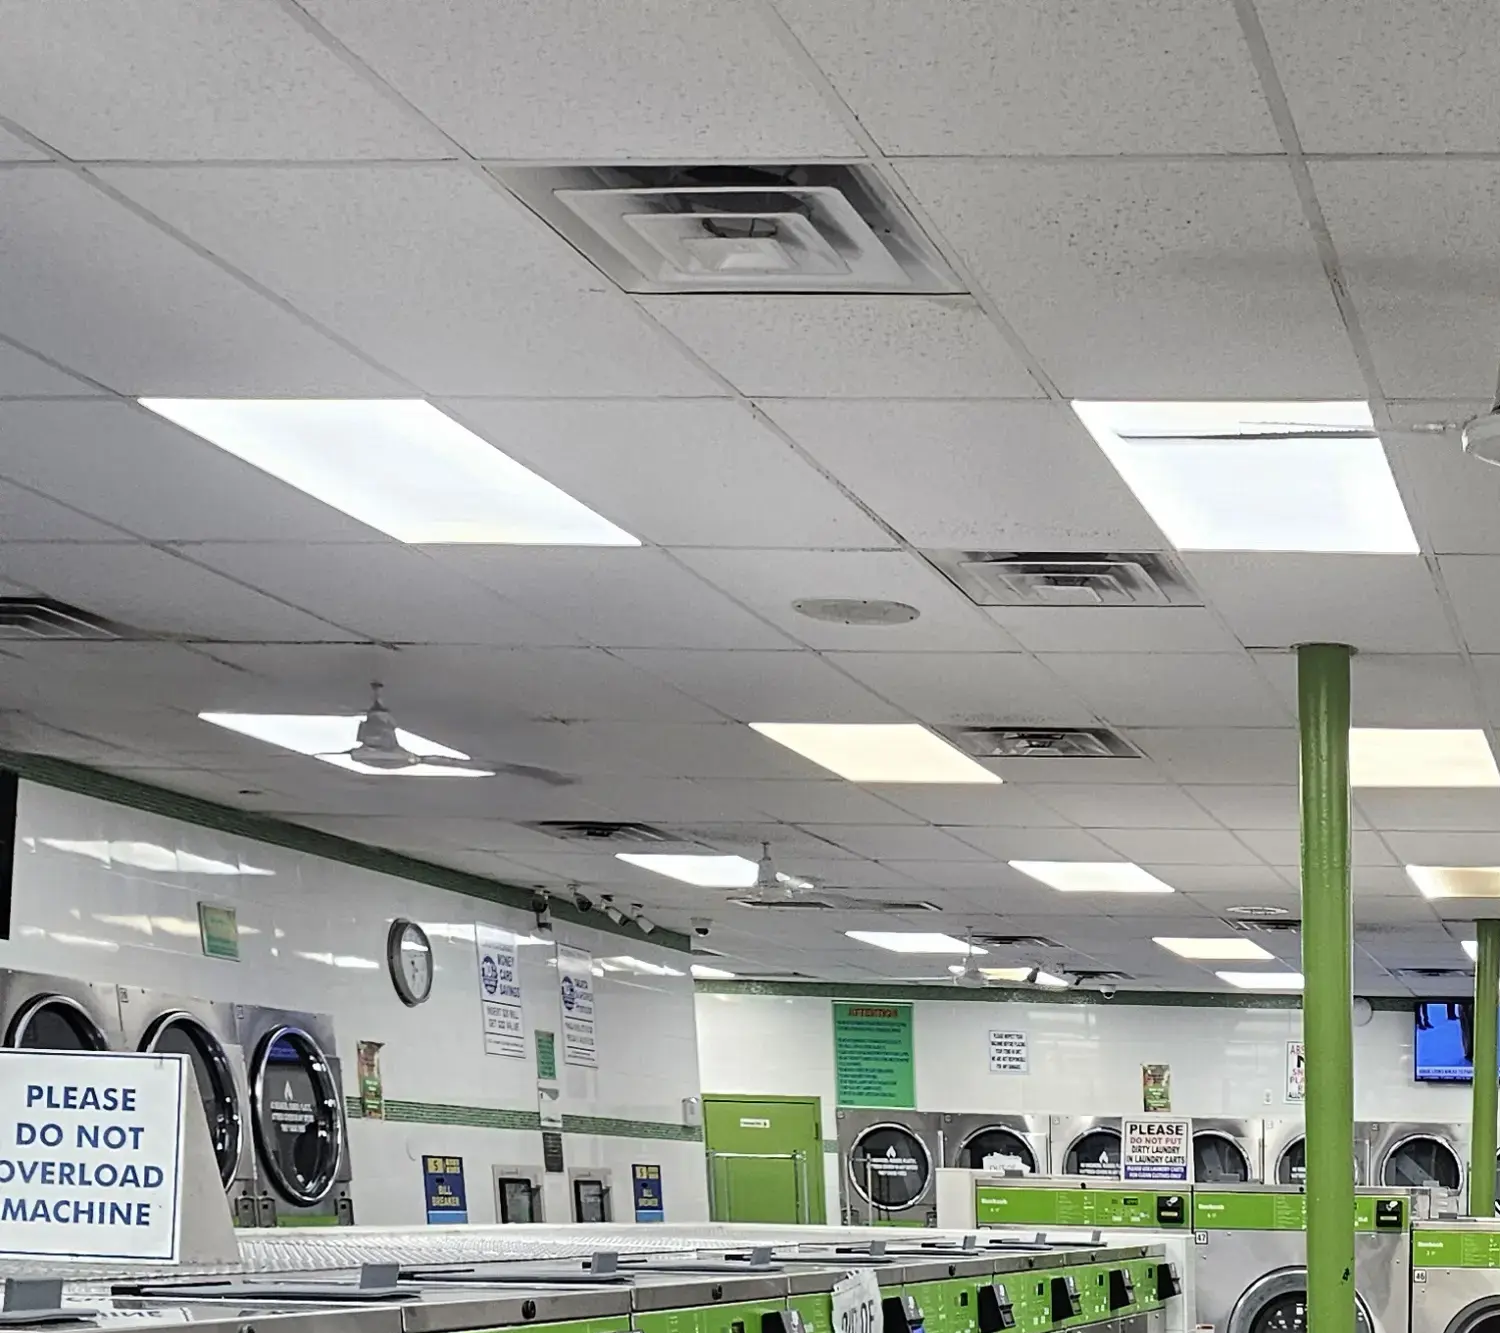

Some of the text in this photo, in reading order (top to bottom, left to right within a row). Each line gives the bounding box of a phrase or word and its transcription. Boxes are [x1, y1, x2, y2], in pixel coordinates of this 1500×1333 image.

[27, 1085, 136, 1112] PLEASE
[16, 1123, 145, 1150] DO NOT
[1129, 1124, 1184, 1136] PLEASE
[1130, 1137, 1142, 1145] DO
[1146, 1137, 1162, 1145] NOT
[1132, 1146, 1180, 1154] DIRTY LAUNDRY
[1135, 1156, 1162, 1164] LAUNDRY
[1165, 1156, 1185, 1164] CARTS
[0, 1160, 164, 1188] OVERLOAD
[1, 1198, 150, 1226] MACHINE
